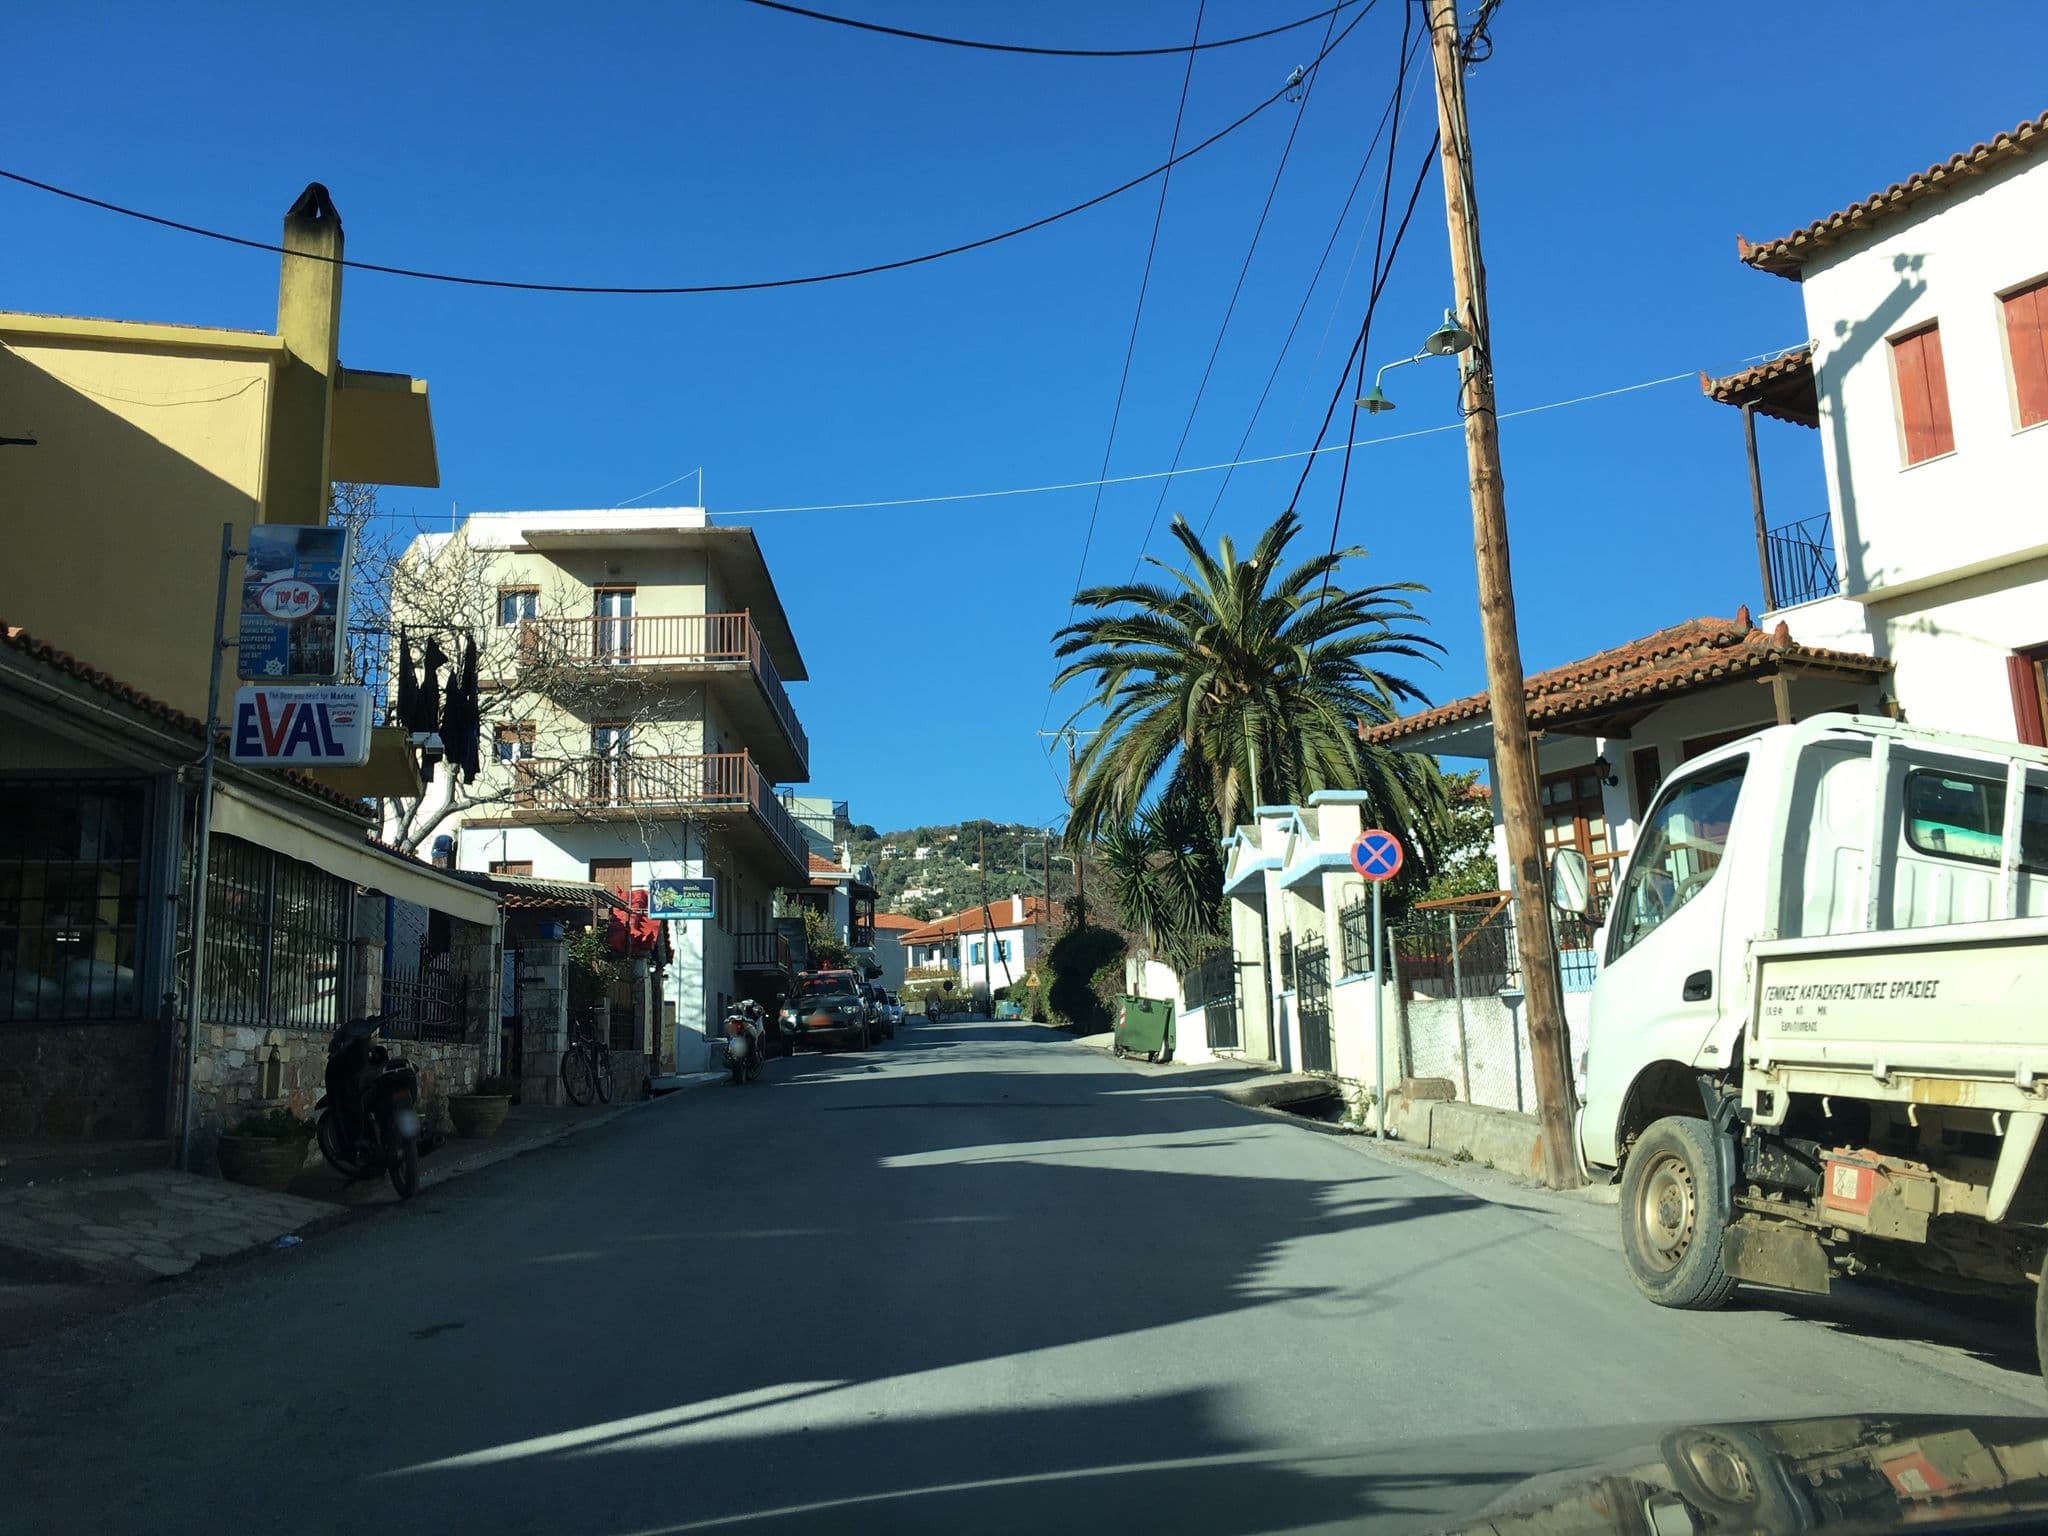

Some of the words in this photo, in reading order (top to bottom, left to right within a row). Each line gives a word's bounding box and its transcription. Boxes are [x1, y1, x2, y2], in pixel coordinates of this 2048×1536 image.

[235, 692, 345, 757] EVAL
[1764, 985, 1799, 1000] ΓΕΝΙΚΕΣ
[1799, 982, 1888, 1000] ΚΑΤΑΣΚΕΥΑΣΤΙΚΕΣ
[1890, 980, 1940, 998] ΕΡΓΑΣΙΕΣ
